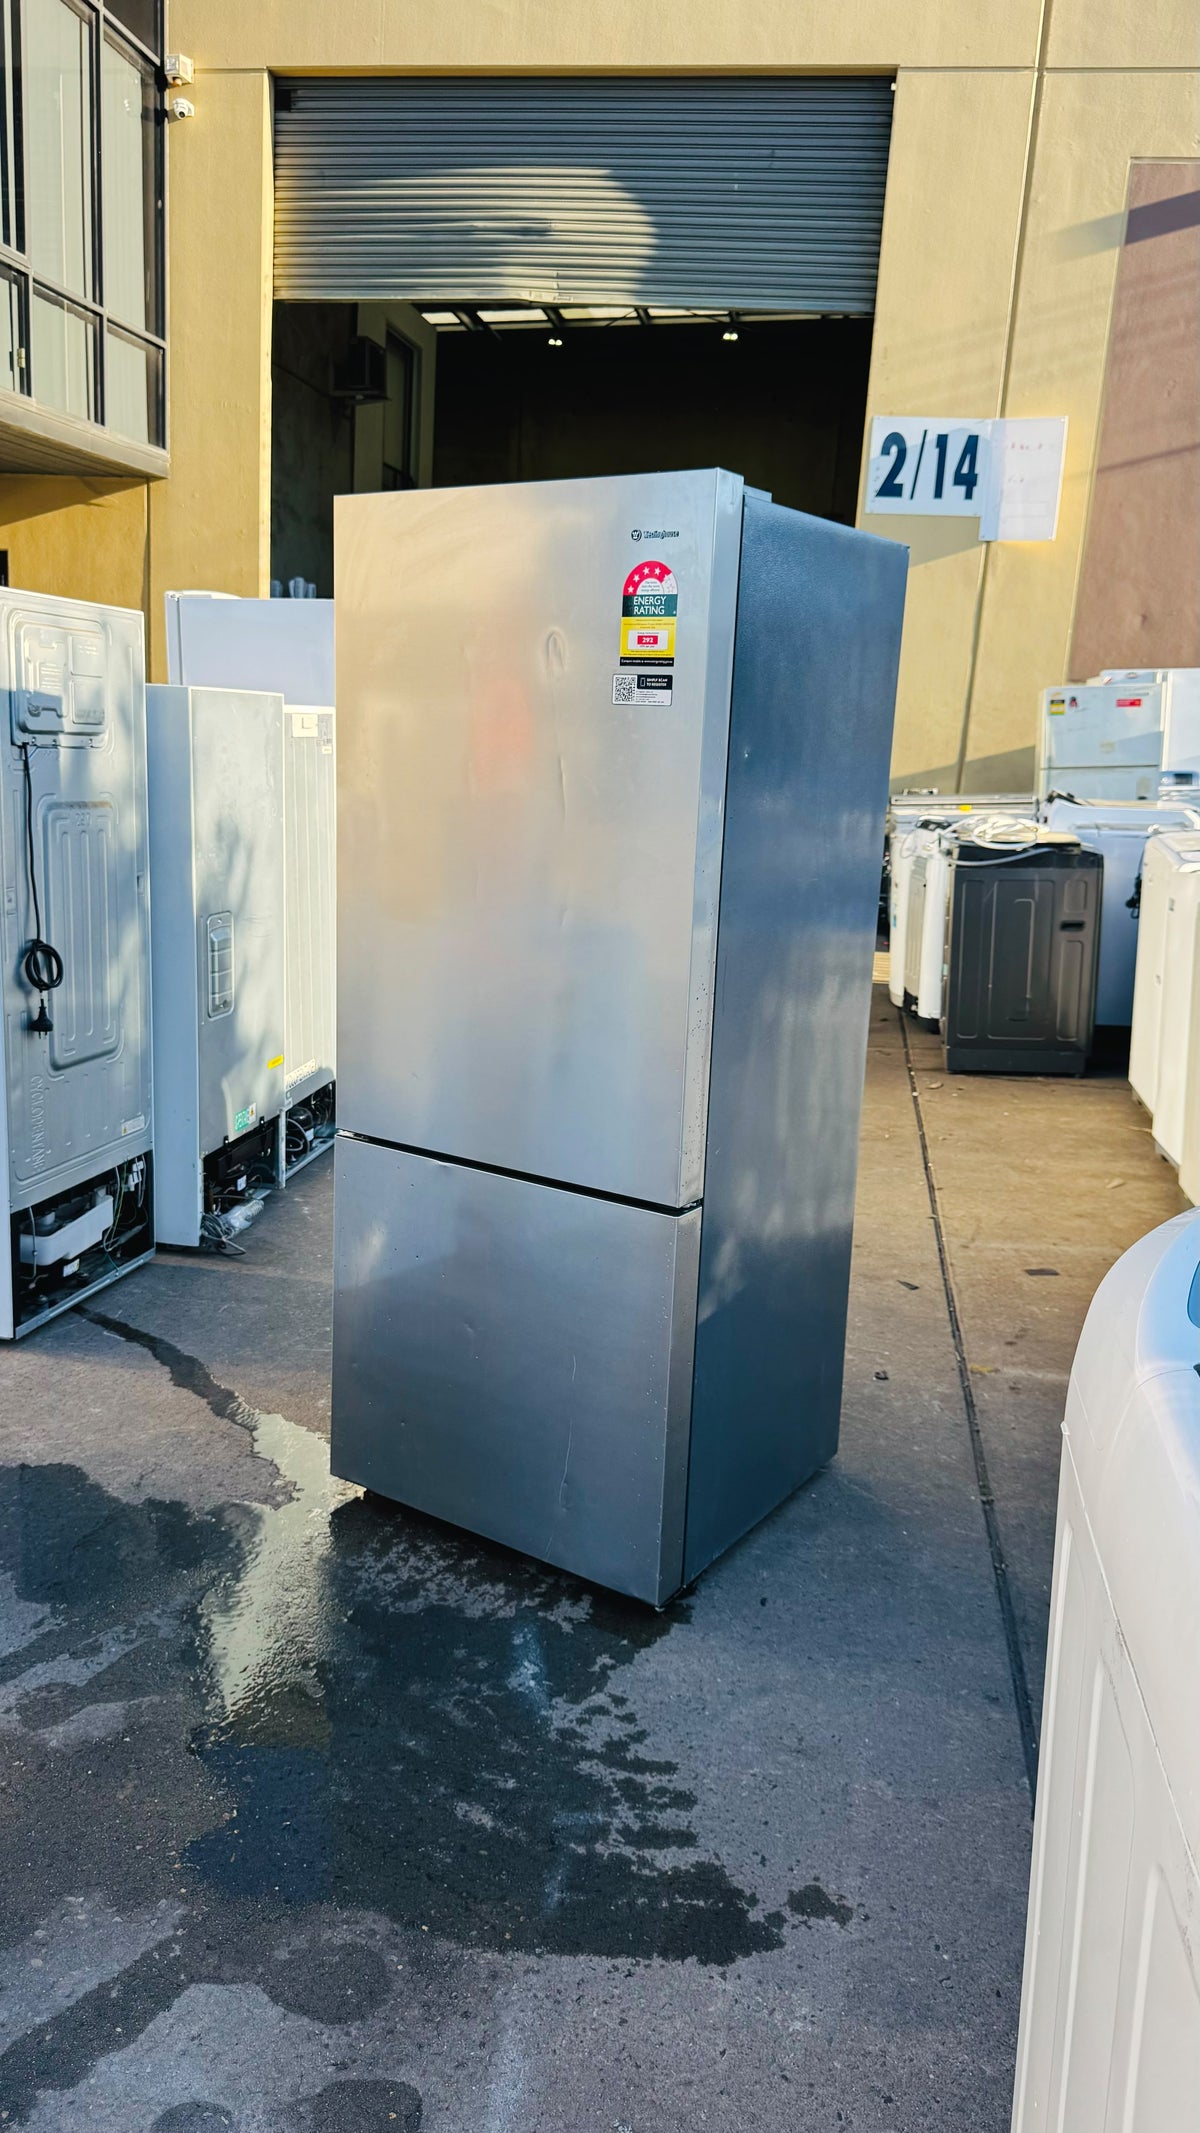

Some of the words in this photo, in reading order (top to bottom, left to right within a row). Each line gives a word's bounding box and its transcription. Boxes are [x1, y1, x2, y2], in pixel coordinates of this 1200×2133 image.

[875, 429, 979, 500] 2/14
[633, 596, 666, 605] ENERGY
[633, 606, 665, 615] RATING
